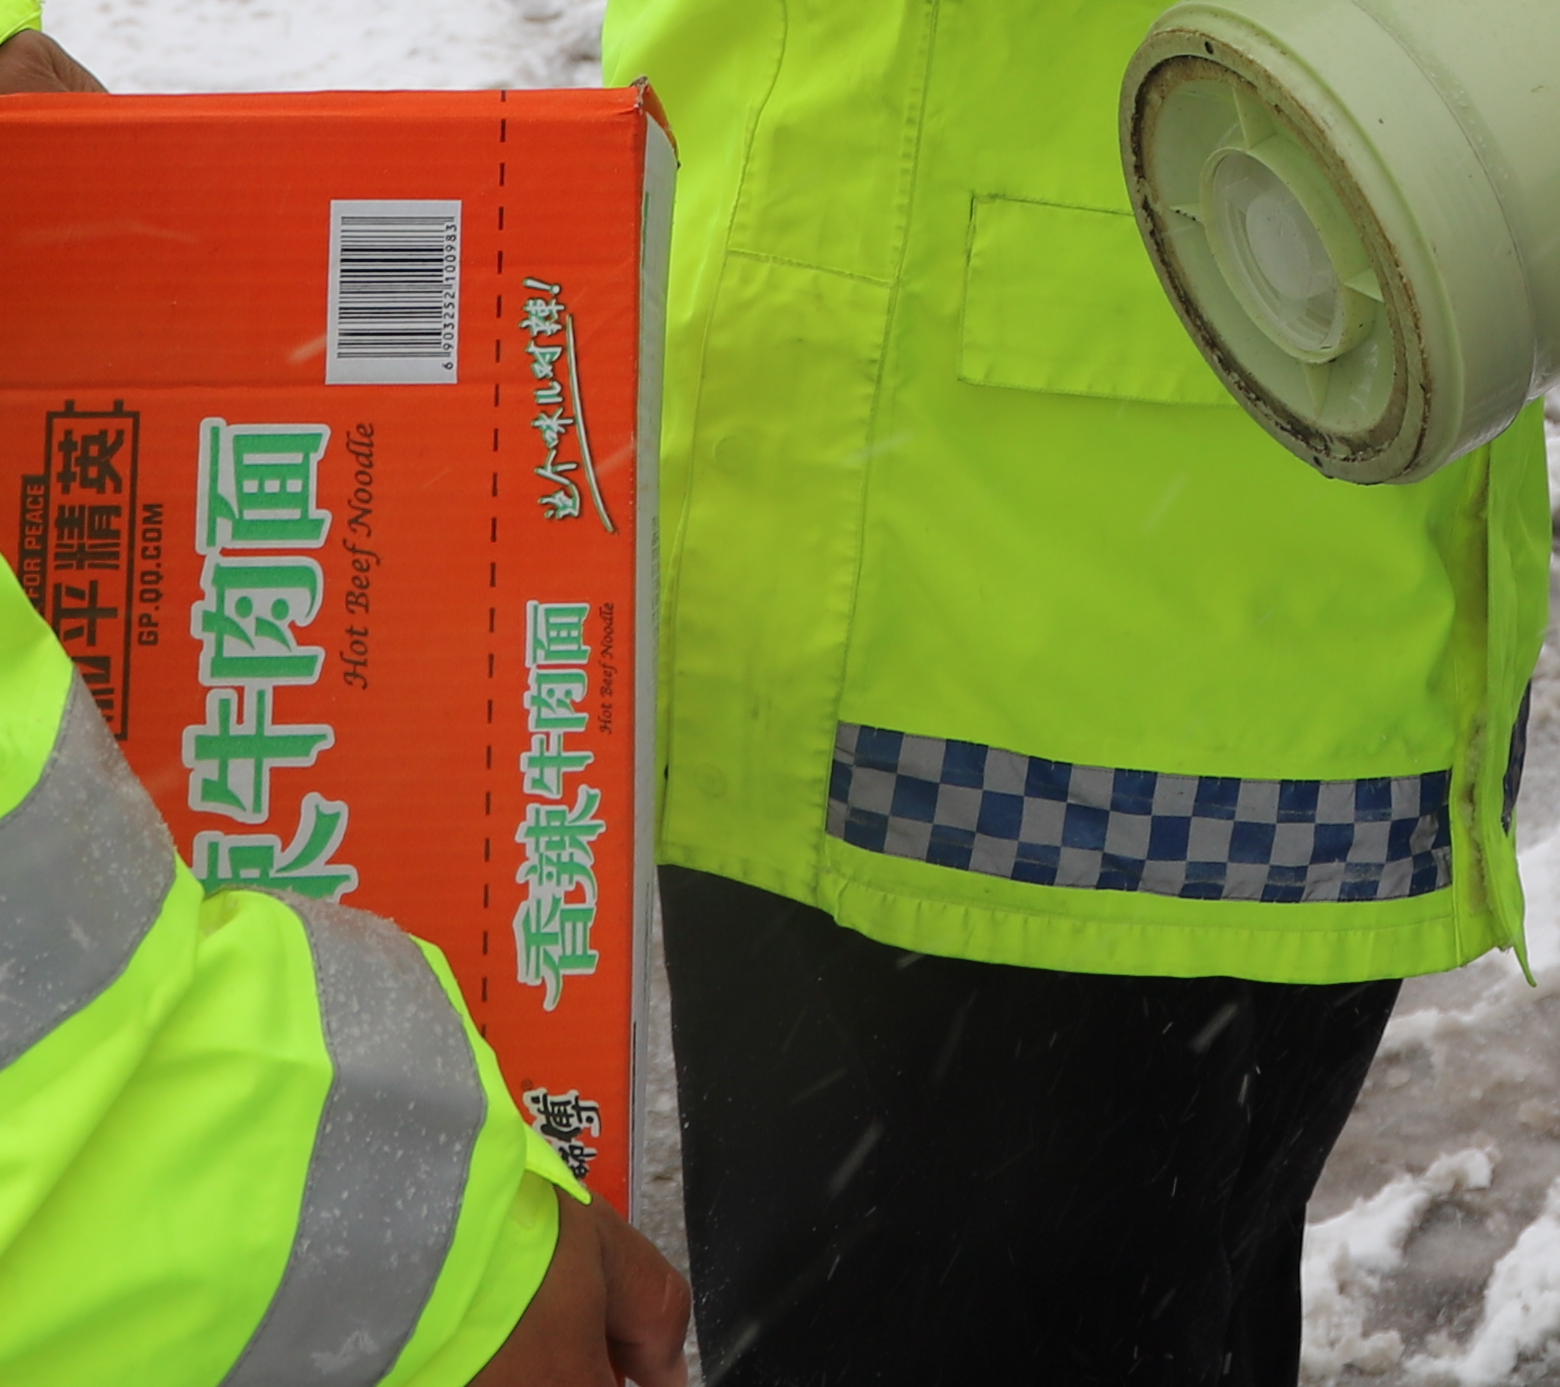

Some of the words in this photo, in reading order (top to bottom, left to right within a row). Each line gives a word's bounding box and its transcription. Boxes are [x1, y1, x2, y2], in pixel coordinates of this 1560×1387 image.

[344, 423, 375, 538] Noodle
[24, 484, 44, 551] PEACE
[23, 557, 43, 599] FOR
[138, 503, 164, 647] GP.QQ.COM
[342, 538, 381, 615] Beef
[340, 626, 371, 690] Hot
[599, 602, 615, 660] Noodle
[599, 662, 617, 697] Beef
[598, 702, 614, 736] Hot
[515, 604, 605, 1008] 香辣牛肉面
